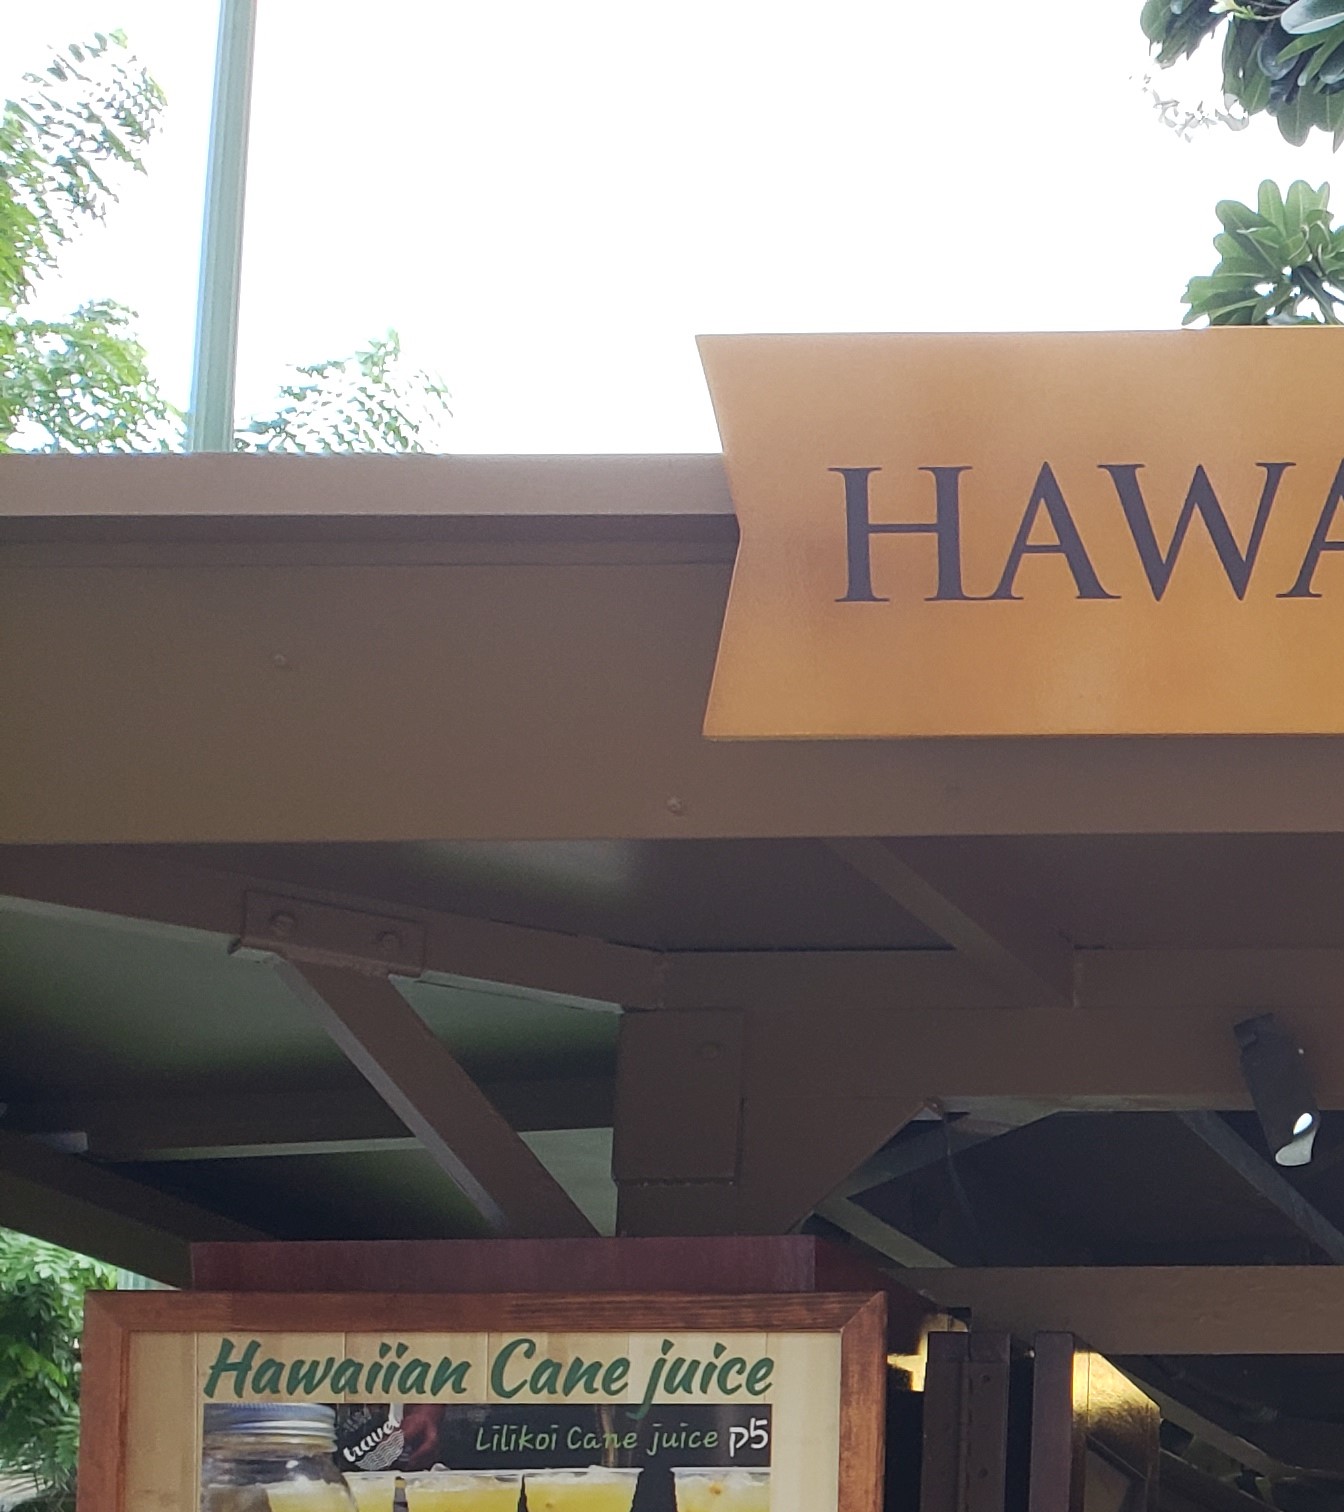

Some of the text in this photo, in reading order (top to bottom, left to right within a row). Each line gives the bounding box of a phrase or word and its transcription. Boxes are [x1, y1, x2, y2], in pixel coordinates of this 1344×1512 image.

[203, 1337, 775, 1420] Hawaiian Cane juice
[475, 1424, 559, 1451] Lilikoi
[567, 1426, 638, 1449] Cane
[646, 1422, 719, 1456] juice
